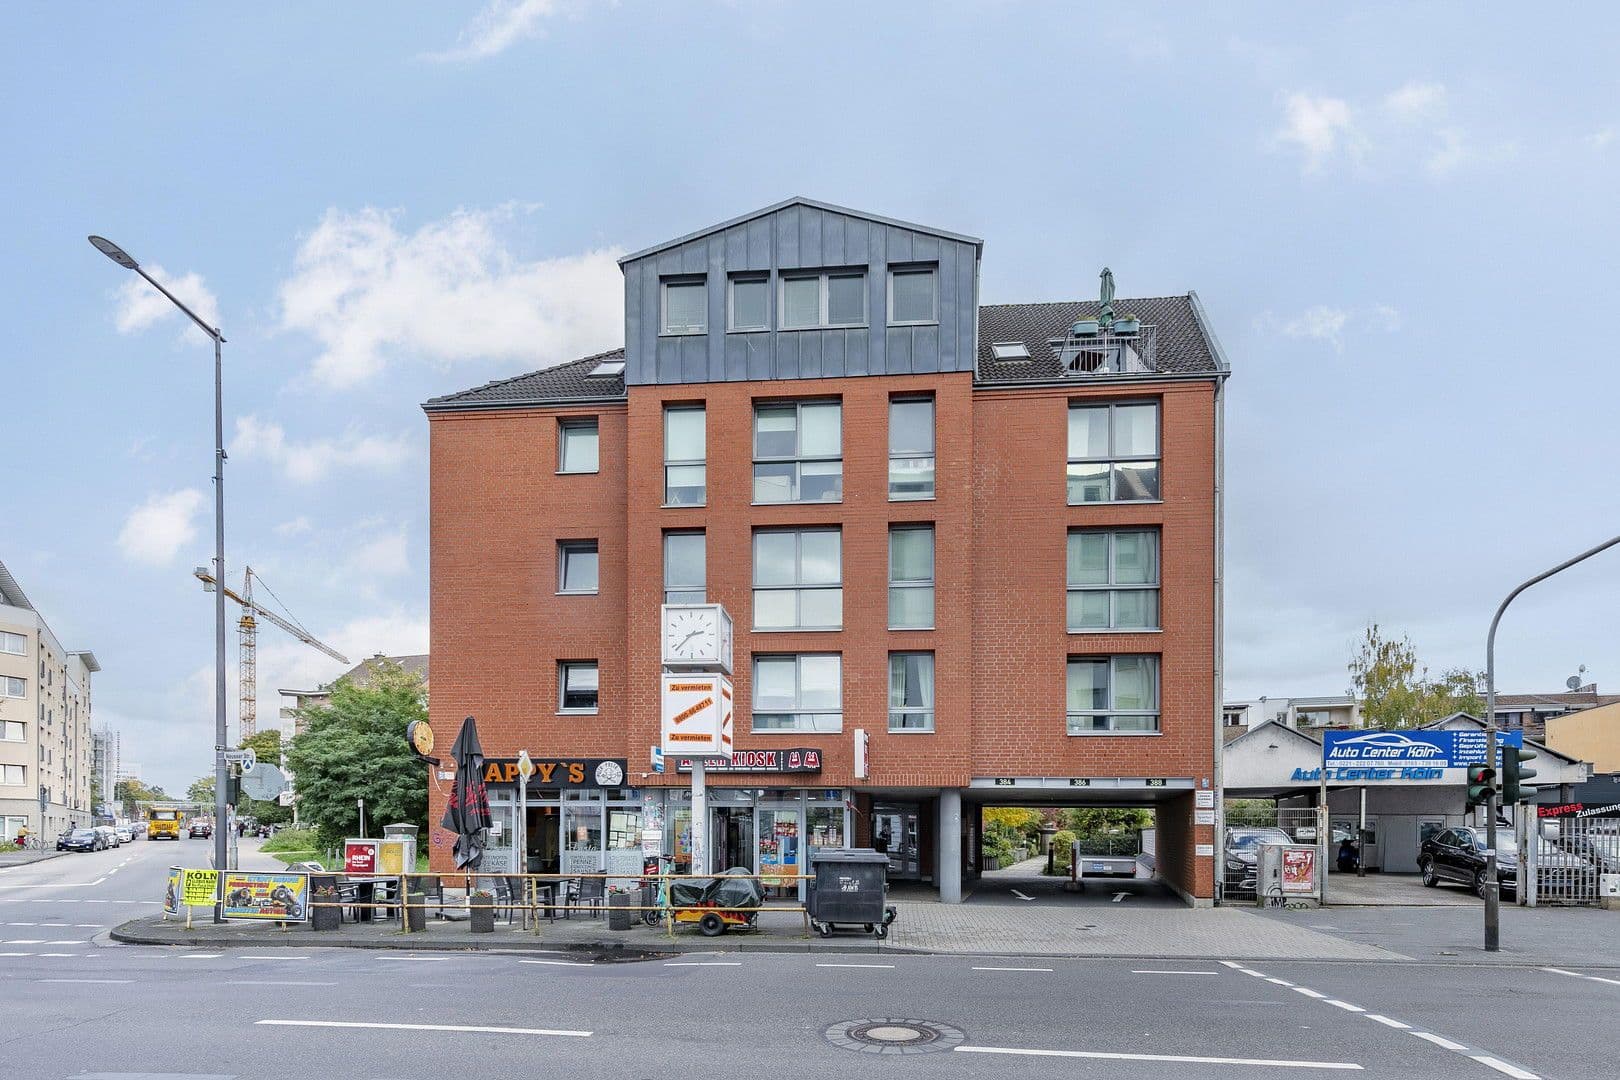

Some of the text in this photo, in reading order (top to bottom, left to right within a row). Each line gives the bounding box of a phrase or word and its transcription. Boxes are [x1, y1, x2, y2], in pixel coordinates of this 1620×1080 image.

[680, 734, 712, 742] vermieten
[1329, 746, 1436, 758] Auto Center Köln
[731, 751, 777, 767] KIOSK
[1291, 767, 1444, 780] Auto Center Köln
[1537, 803, 1584, 817] Express
[186, 870, 217, 880] KÖLN
